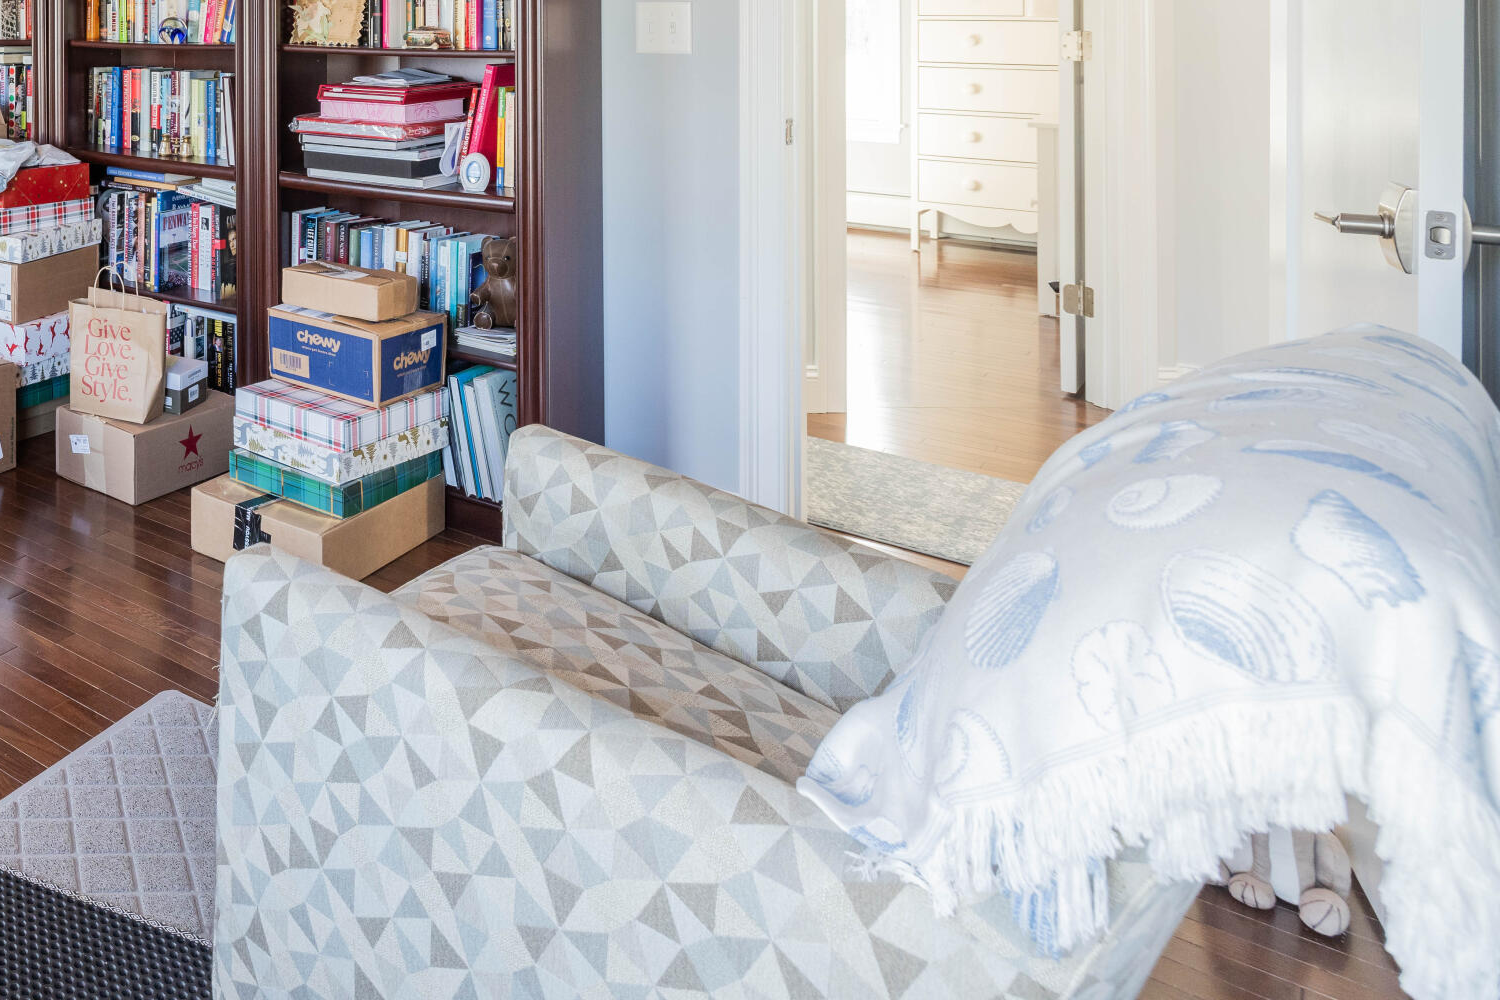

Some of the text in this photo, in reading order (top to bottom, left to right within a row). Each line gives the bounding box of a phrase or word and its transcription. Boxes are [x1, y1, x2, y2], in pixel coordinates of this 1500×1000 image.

[87, 318, 132, 342] Give
[296, 329, 341, 353] chewy
[84, 334, 135, 361] Love.
[393, 348, 431, 371] chewy
[84, 355, 129, 379] Give
[81, 375, 133, 403] Style.
